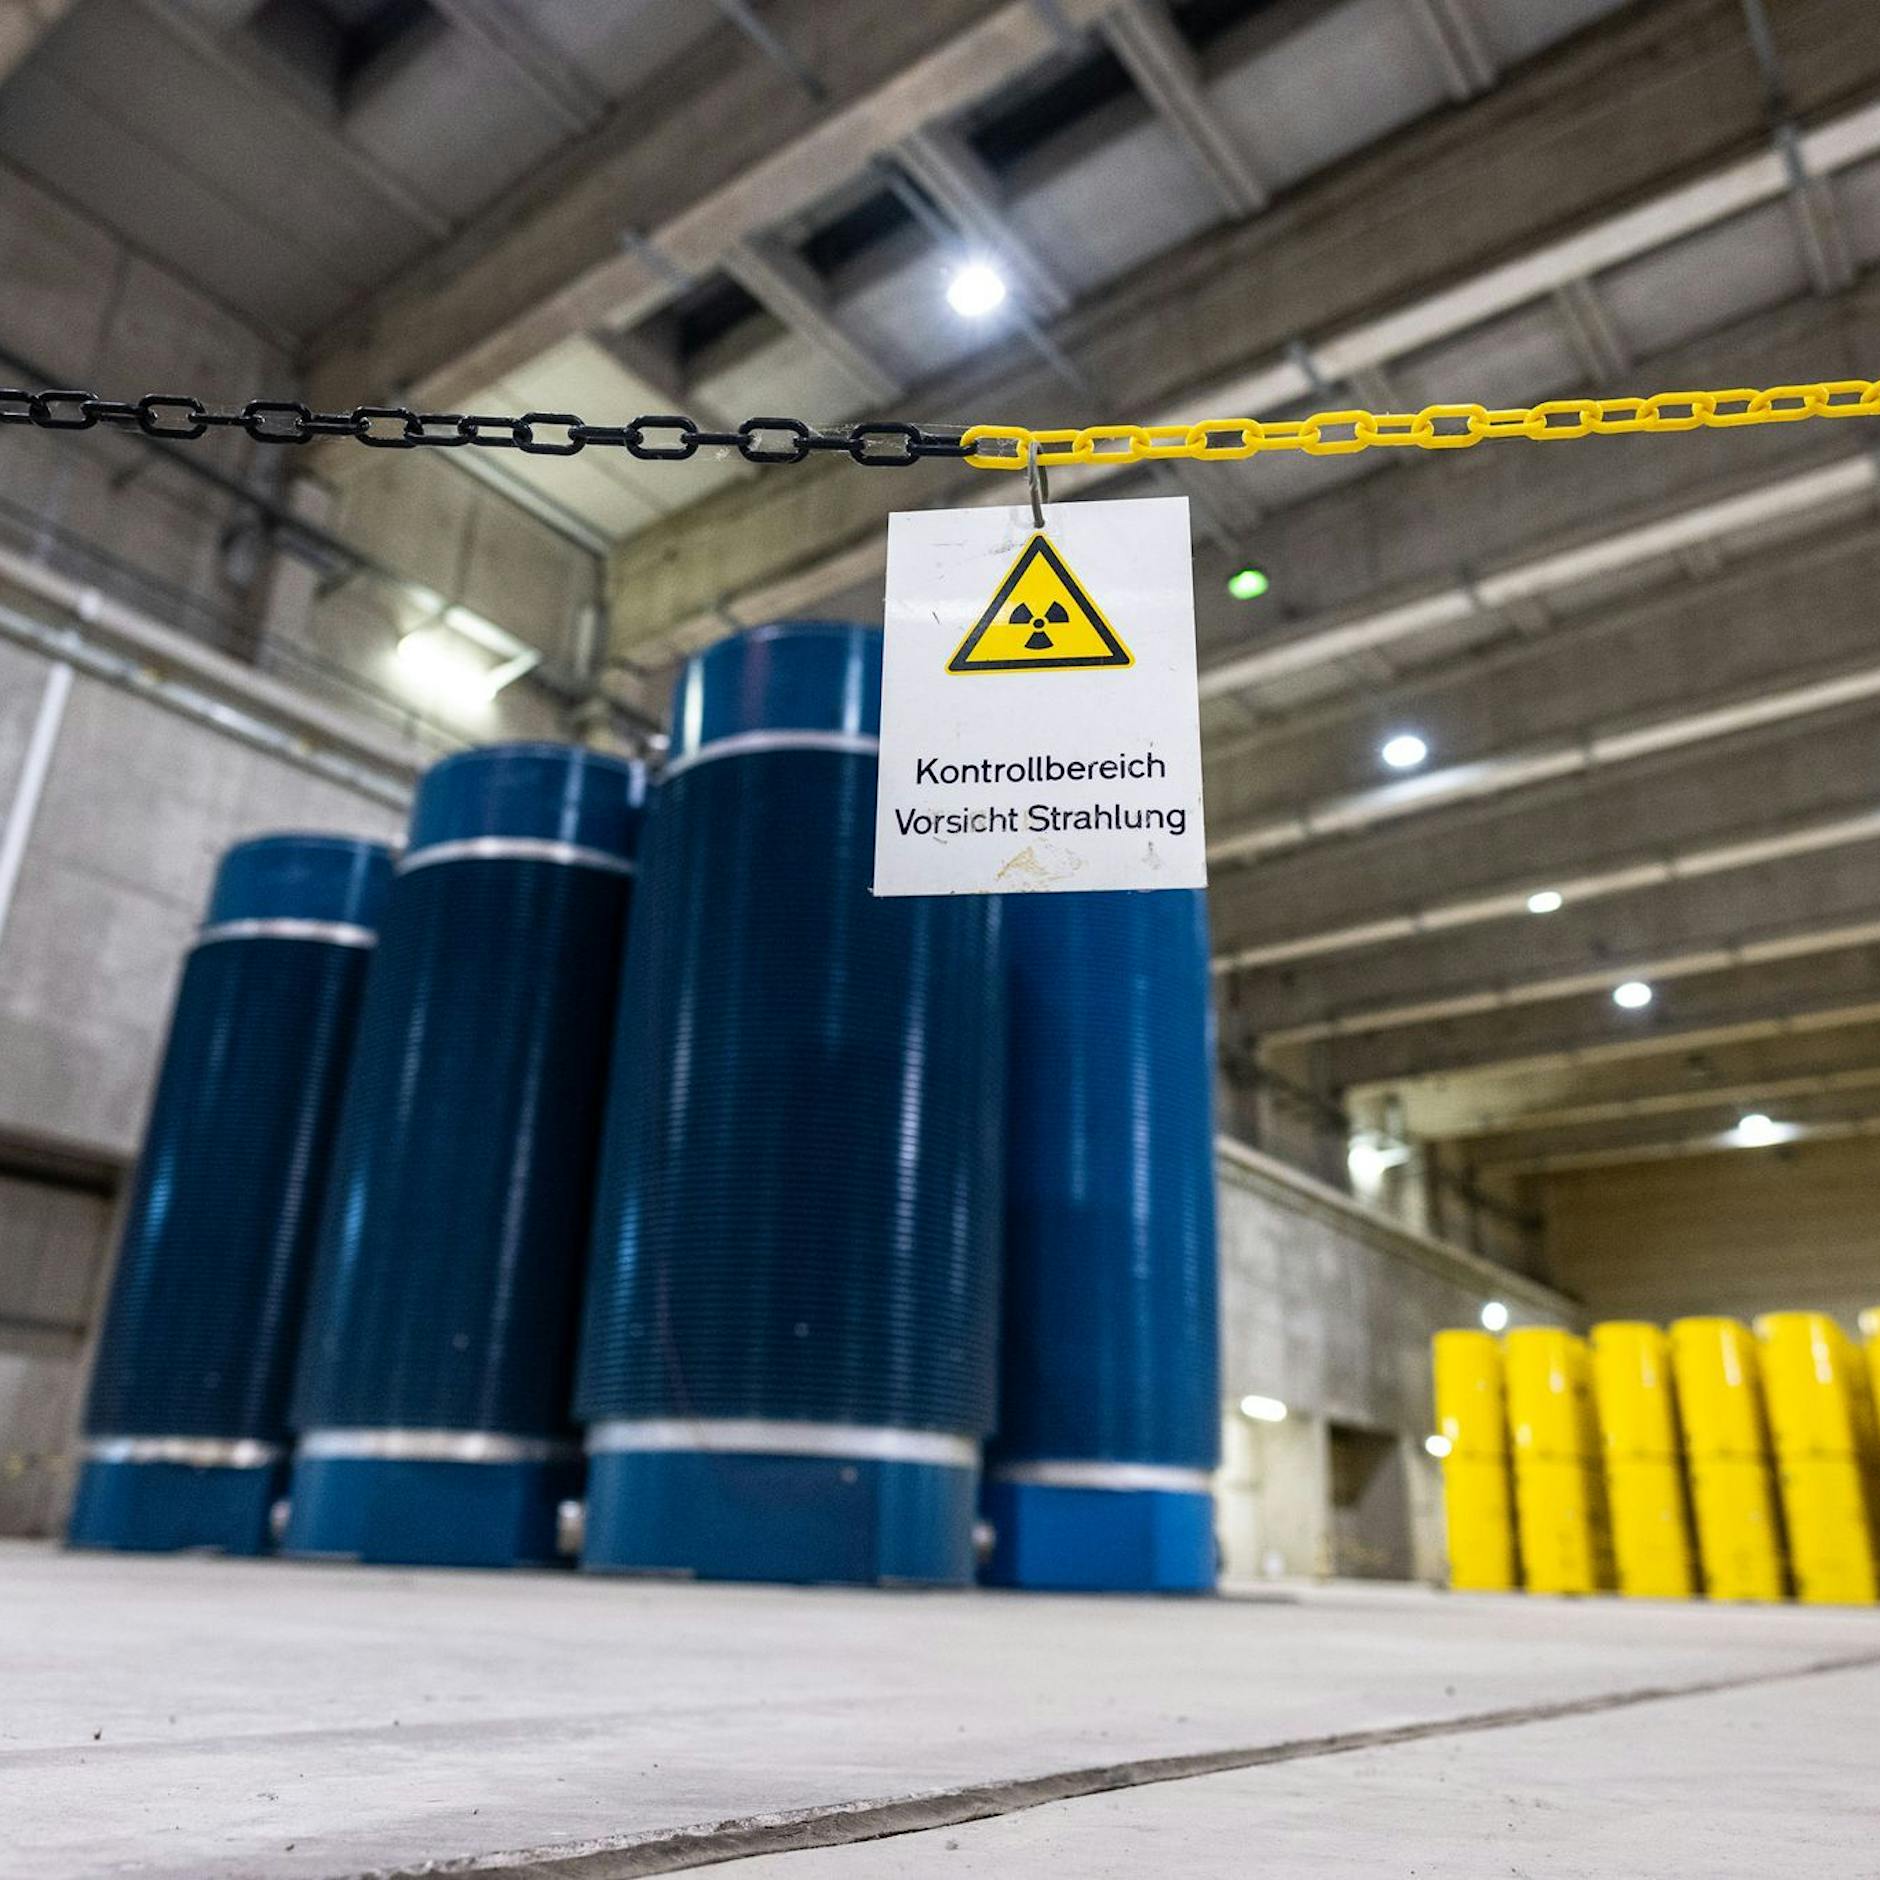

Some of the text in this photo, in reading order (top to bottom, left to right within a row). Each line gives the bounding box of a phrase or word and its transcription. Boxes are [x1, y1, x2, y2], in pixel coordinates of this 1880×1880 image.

[916, 753, 1166, 785] Kontrollbereich
[895, 803, 1187, 836] Vorsicht Strahlung
